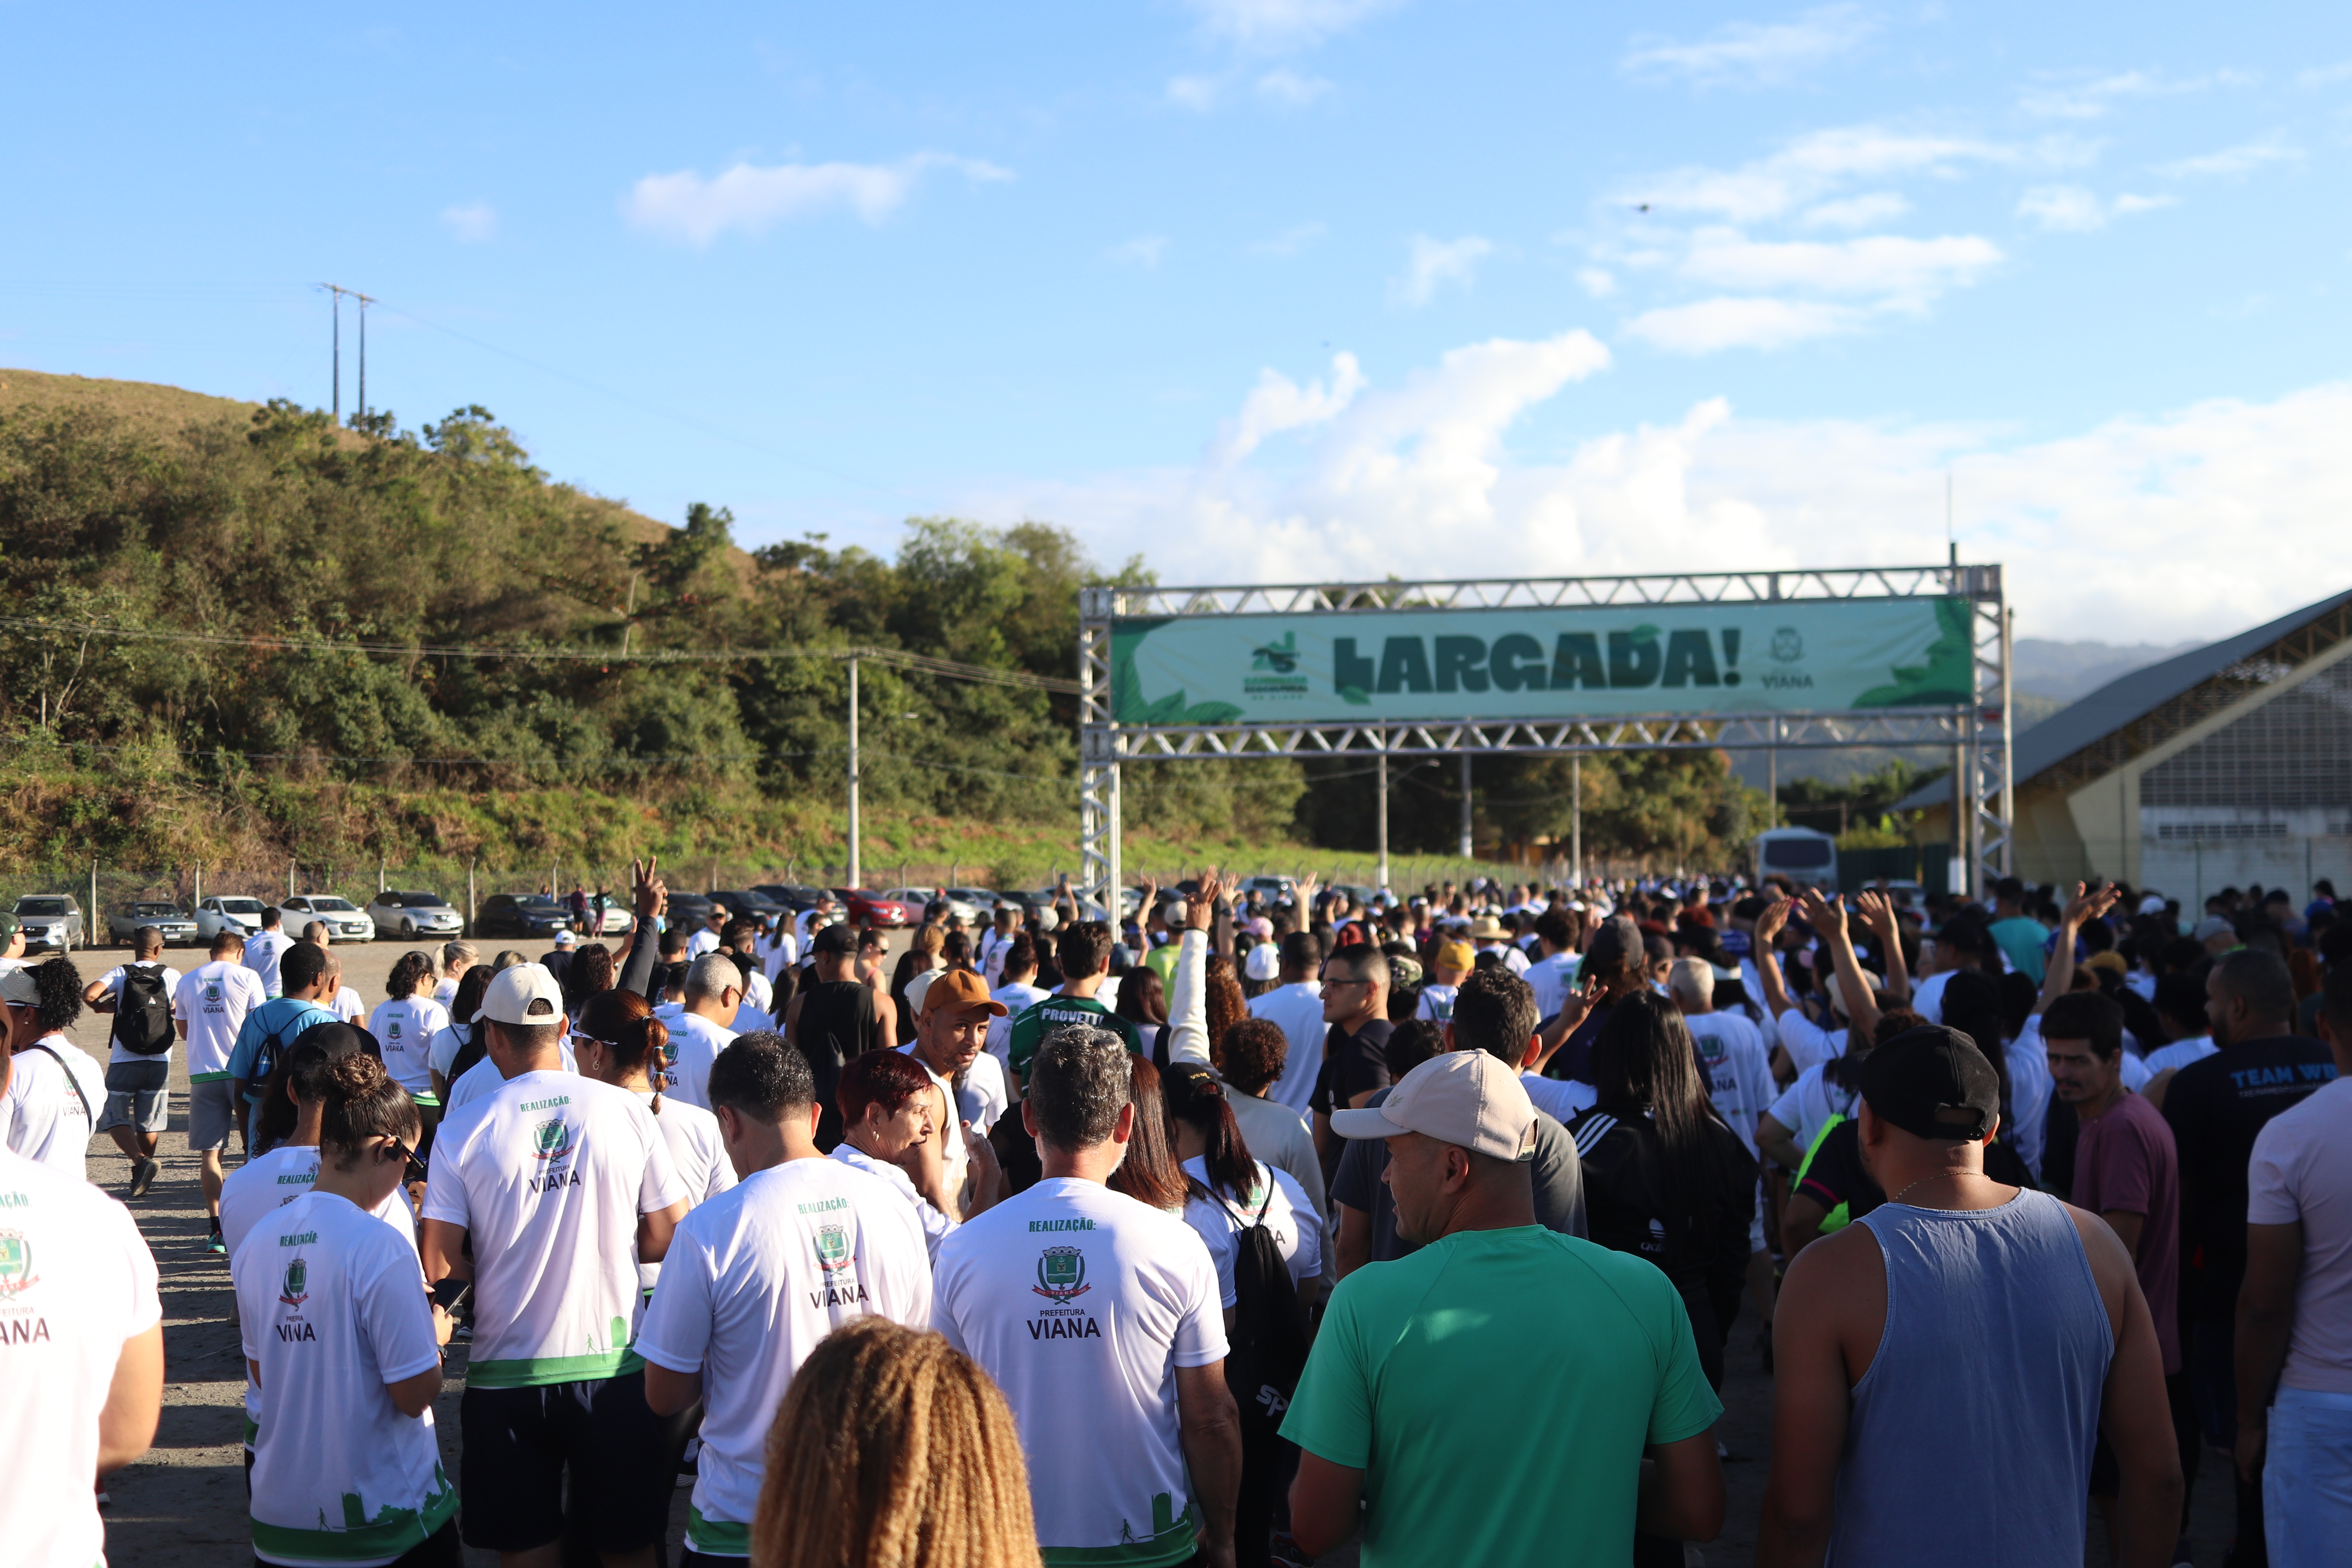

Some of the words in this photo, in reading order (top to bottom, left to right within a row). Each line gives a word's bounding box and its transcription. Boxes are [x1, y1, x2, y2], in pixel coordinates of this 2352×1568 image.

[1334, 629, 1741, 694] LARGADA!
[650, 1073, 679, 1086] VNA
[2230, 1065, 2294, 1089] TEAM
[63, 1106, 86, 1116] VIANA
[520, 1095, 572, 1112] REALIZAÇÃO:
[539, 1164, 570, 1176] PREFEITURA
[529, 1170, 581, 1194] VIANA
[797, 1197, 850, 1214] REALIZAÇÃO:
[1029, 1217, 1096, 1232] REALIZAÇÃO:
[820, 1278, 856, 1288] PREFEITURA
[809, 1284, 869, 1309] VIANA
[1040, 1308, 1085, 1317] PREFEITURA
[1026, 1318, 1102, 1340] VIANA
